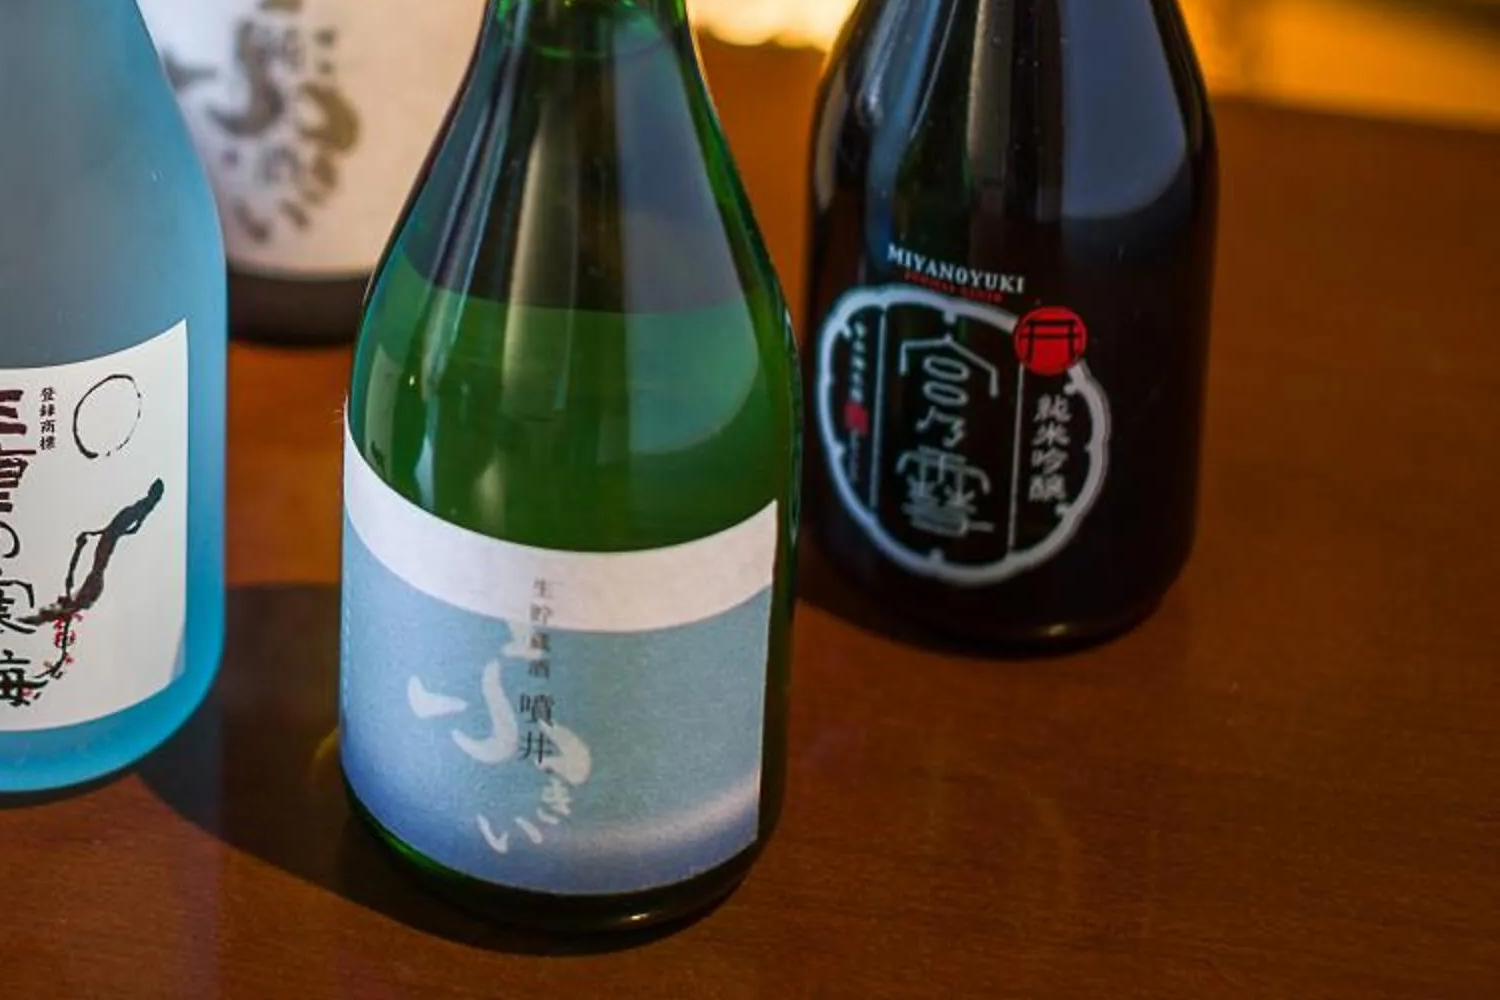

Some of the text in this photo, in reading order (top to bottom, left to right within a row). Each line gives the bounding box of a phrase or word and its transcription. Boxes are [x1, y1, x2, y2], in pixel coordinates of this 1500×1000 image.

[887, 243, 1025, 293] MIYANOYUKI
[1028, 393, 1073, 501] 純米吟醸
[528, 578, 554, 679] 生貯蔵酒
